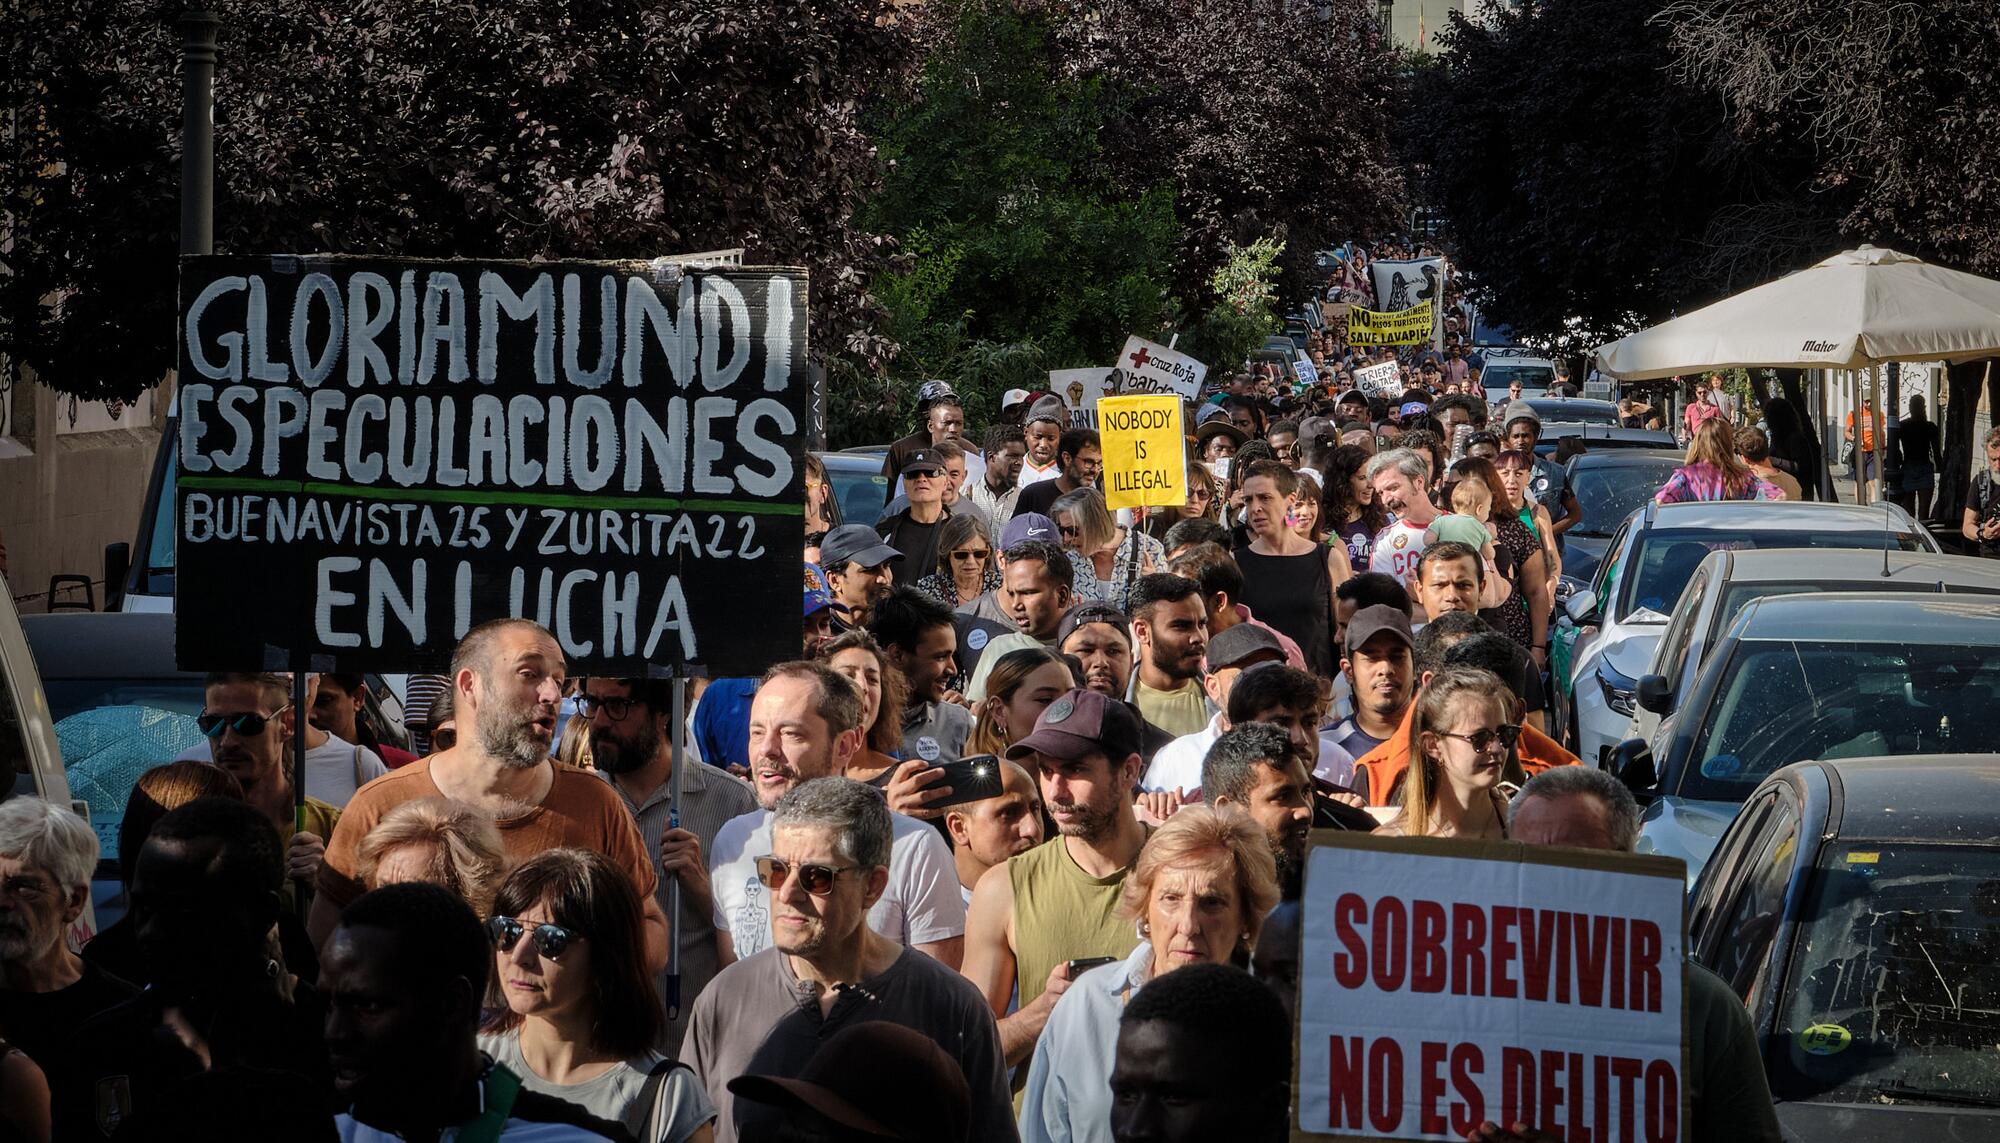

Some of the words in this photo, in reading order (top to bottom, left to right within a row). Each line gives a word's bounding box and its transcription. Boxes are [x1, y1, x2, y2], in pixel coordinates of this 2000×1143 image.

[1351, 308, 1371, 327] NO
[1372, 320, 1391, 329] PISOS
[1393, 316, 1430, 327] TURÍSTICOS
[1351, 331, 1377, 344] SAVE
[1172, 363, 1196, 385] Roja
[1362, 378, 1394, 391] CAPITAL
[1127, 371, 1193, 401] bando
[1105, 409, 1171, 431] NOBODY
[180, 384, 796, 497] ESPECULACIONES
[1135, 440, 1147, 459] IS
[1114, 470, 1171, 492] ILLEGAL
[505, 508, 528, 551] Y
[315, 556, 427, 648] EN
[1333, 892, 1662, 1013] SOBREVIVIR
[1329, 1034, 1404, 1133] NO
[1420, 1041, 1485, 1139] ES
[1502, 1046, 1678, 1143] DELITO
